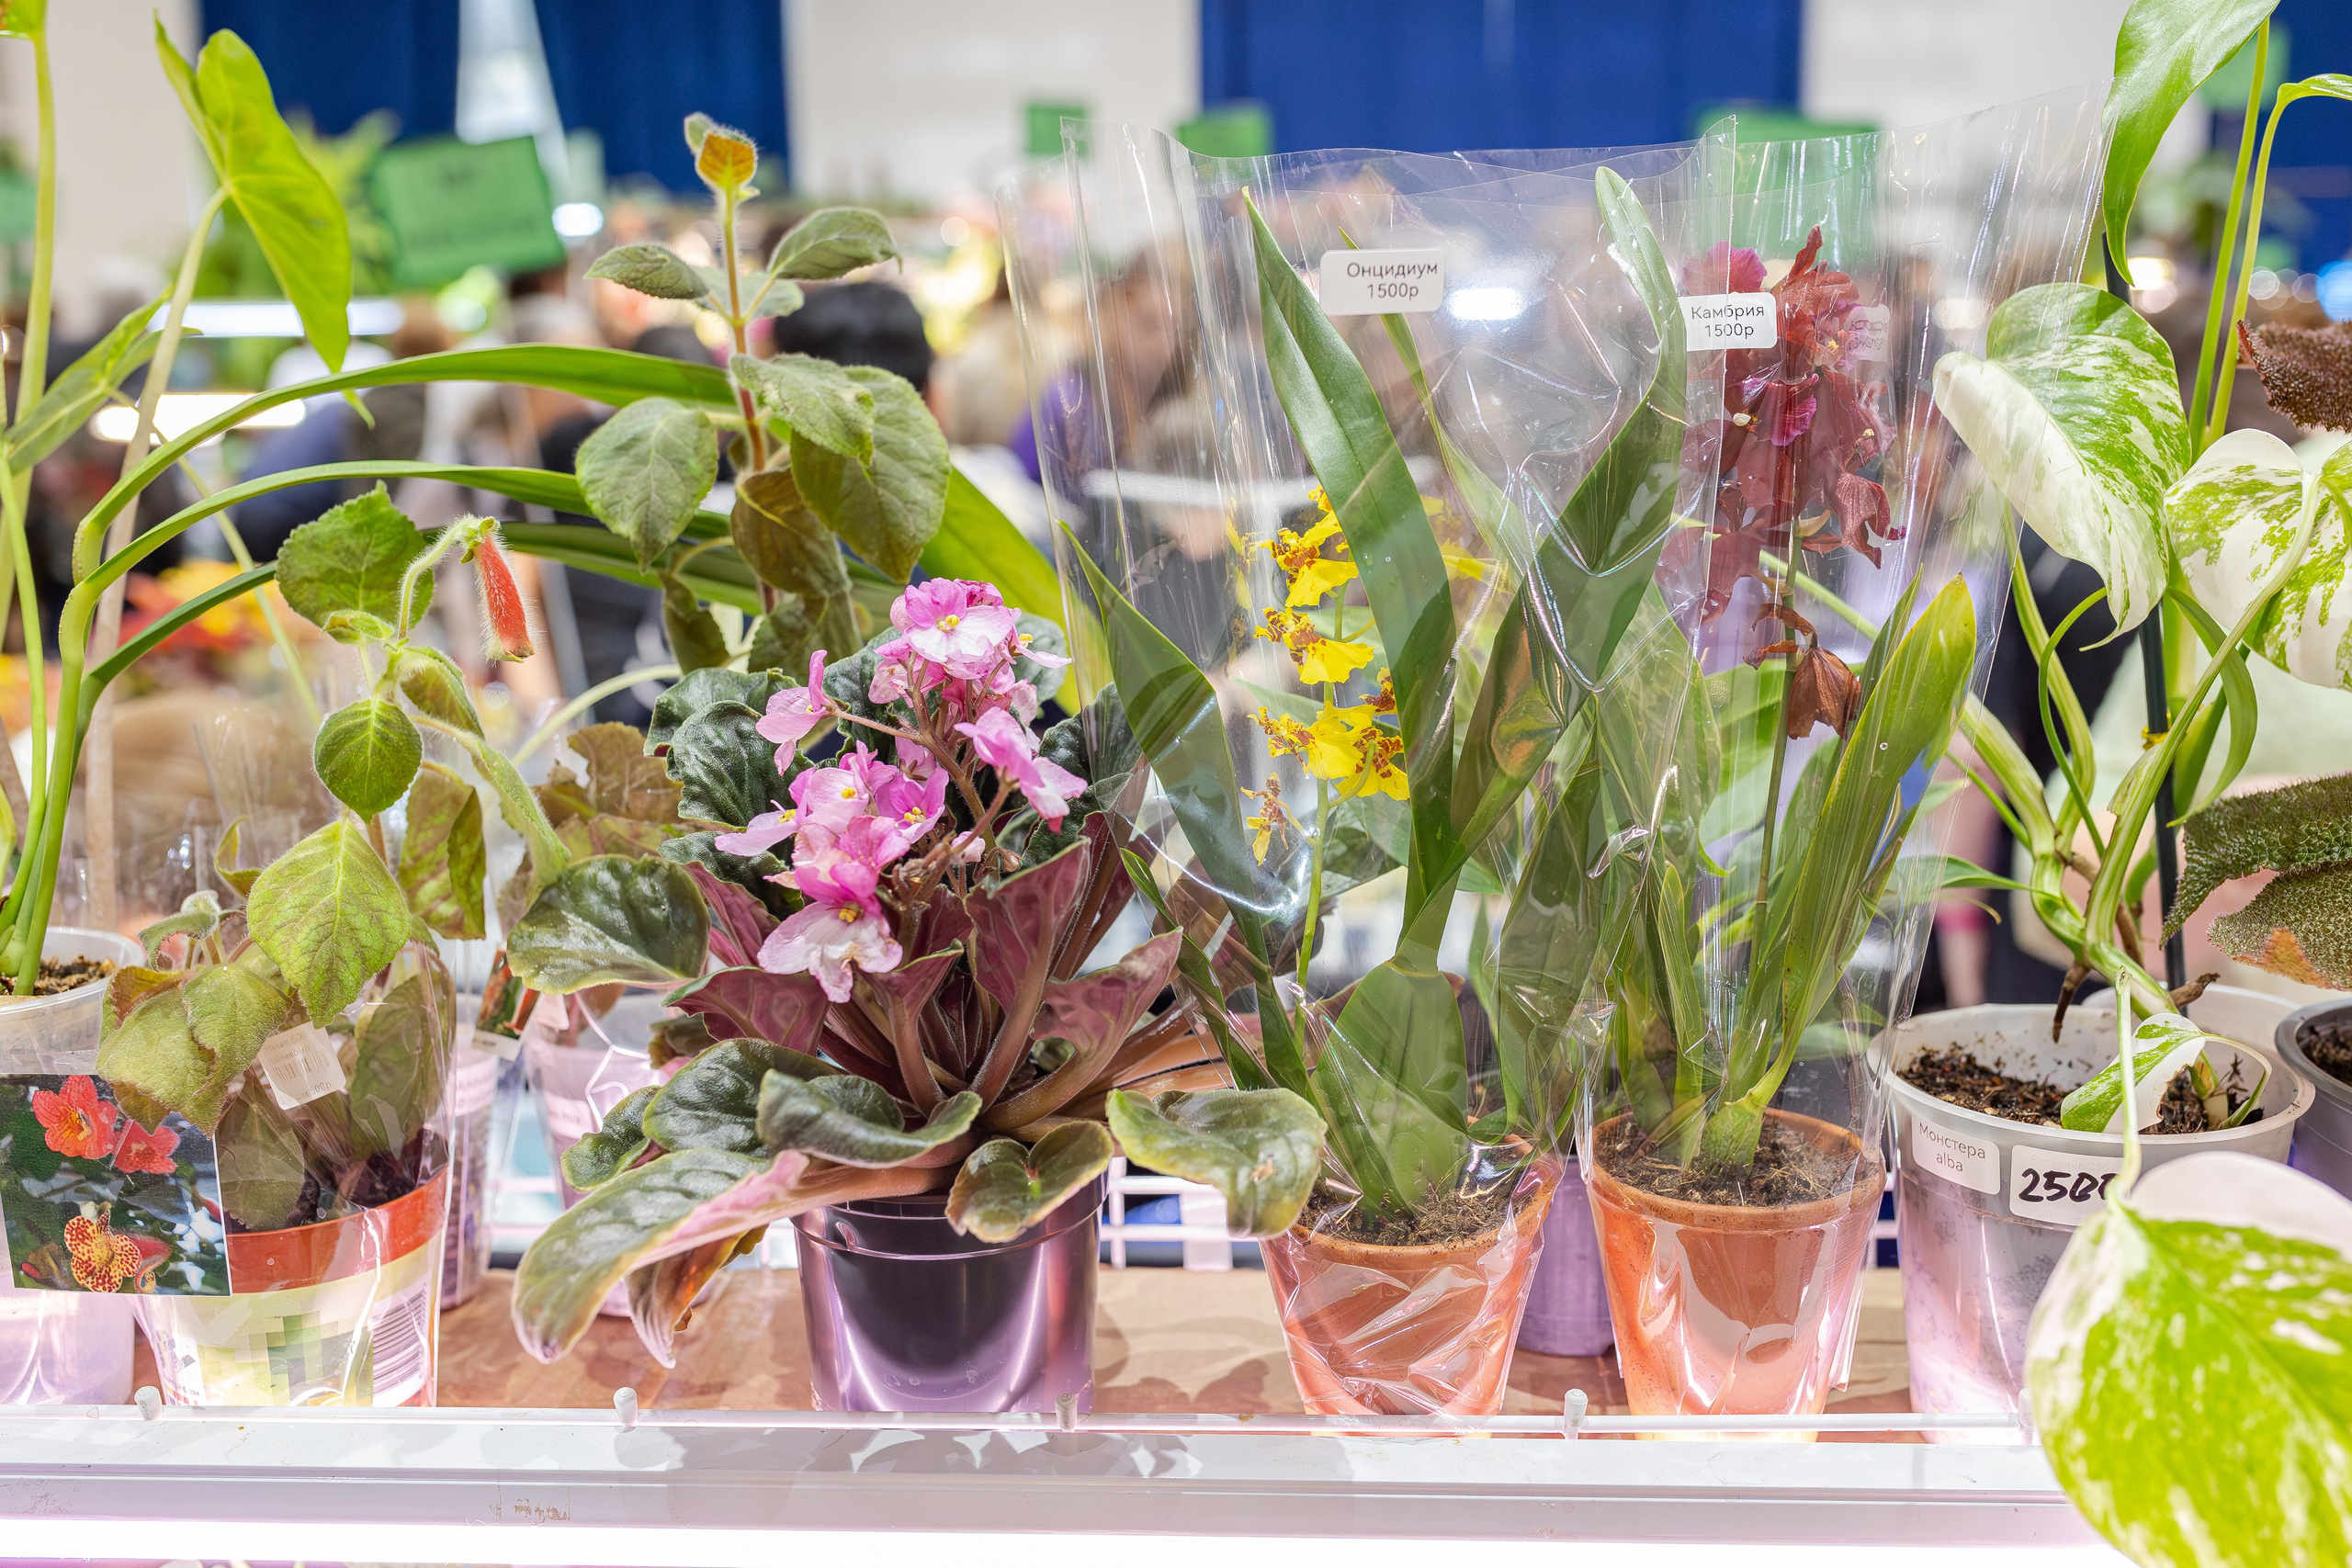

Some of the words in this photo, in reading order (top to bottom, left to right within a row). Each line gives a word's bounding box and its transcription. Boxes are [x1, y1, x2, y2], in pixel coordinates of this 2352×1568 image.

[1347, 263, 1437, 279] Онцидиум
[1367, 283, 1419, 300] 1500р
[1691, 304, 1764, 321] Камбрия
[1704, 322, 1754, 339] 1500р
[1919, 1122, 1985, 1159] Монстера
[1936, 1152, 1963, 1172] alba
